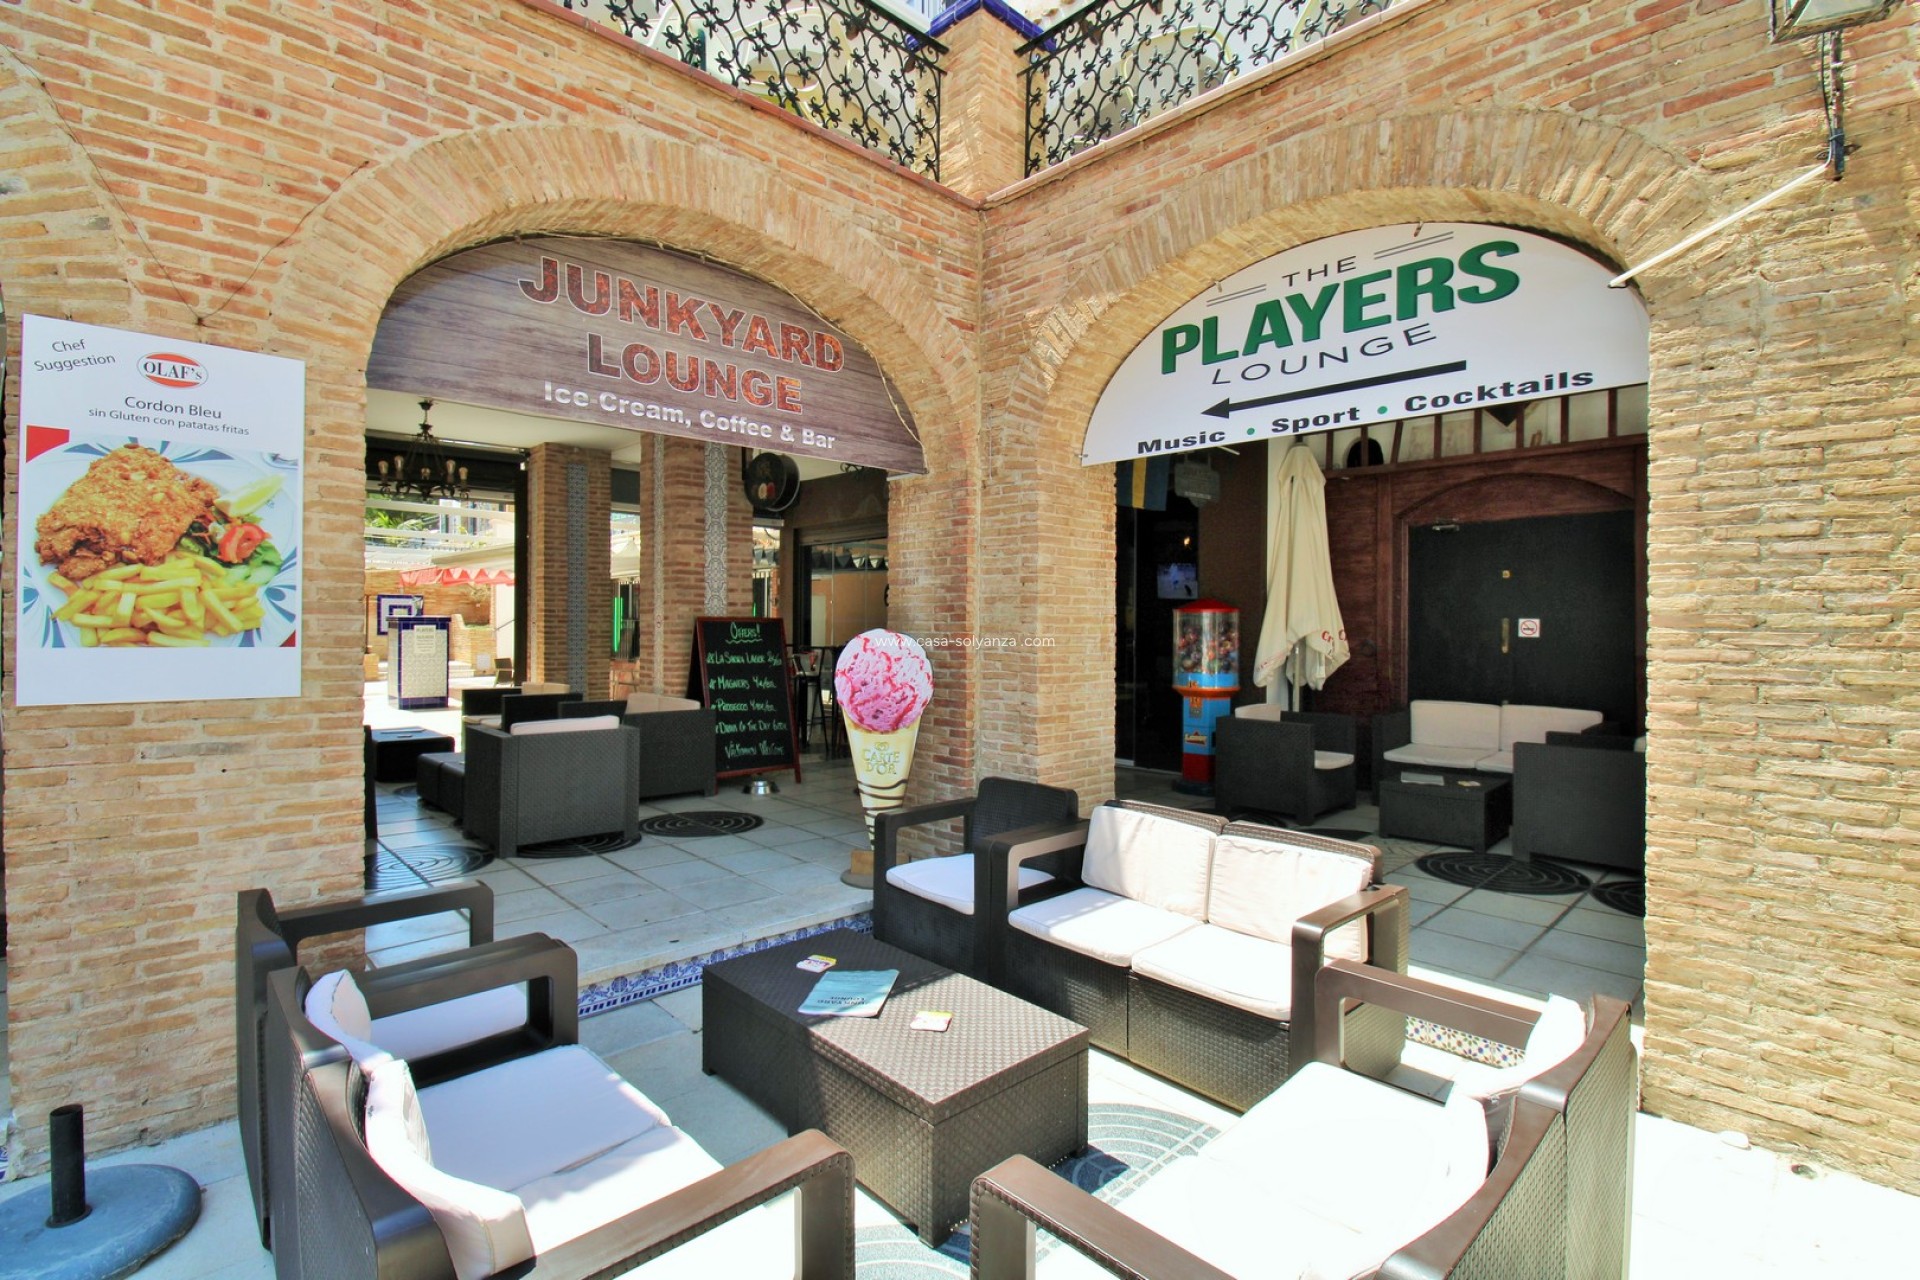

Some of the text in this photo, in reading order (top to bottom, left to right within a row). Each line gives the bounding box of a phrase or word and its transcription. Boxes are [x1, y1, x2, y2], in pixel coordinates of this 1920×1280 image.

[1282, 255, 1357, 288] THE
[517, 256, 845, 373] JUNKYARD
[1161, 240, 1520, 375] PLAYERS
[52, 338, 86, 353] Chef
[1211, 323, 1437, 385] LOUNGE
[34, 353, 116, 372] Suggestion
[143, 361, 202, 381] OLAF's
[587, 332, 803, 415] LOUNGE
[89, 407, 250, 436] sin Gluten con patatas fritas
[124, 396, 222, 420] Cordon Bleu
[544, 381, 836, 450] Ice Cream, Coffee & Bar
[1137, 370, 1594, 455] Music Sport Cocktails
[862, 748, 900, 763] CARTE
[865, 761, 896, 775] D'OR
